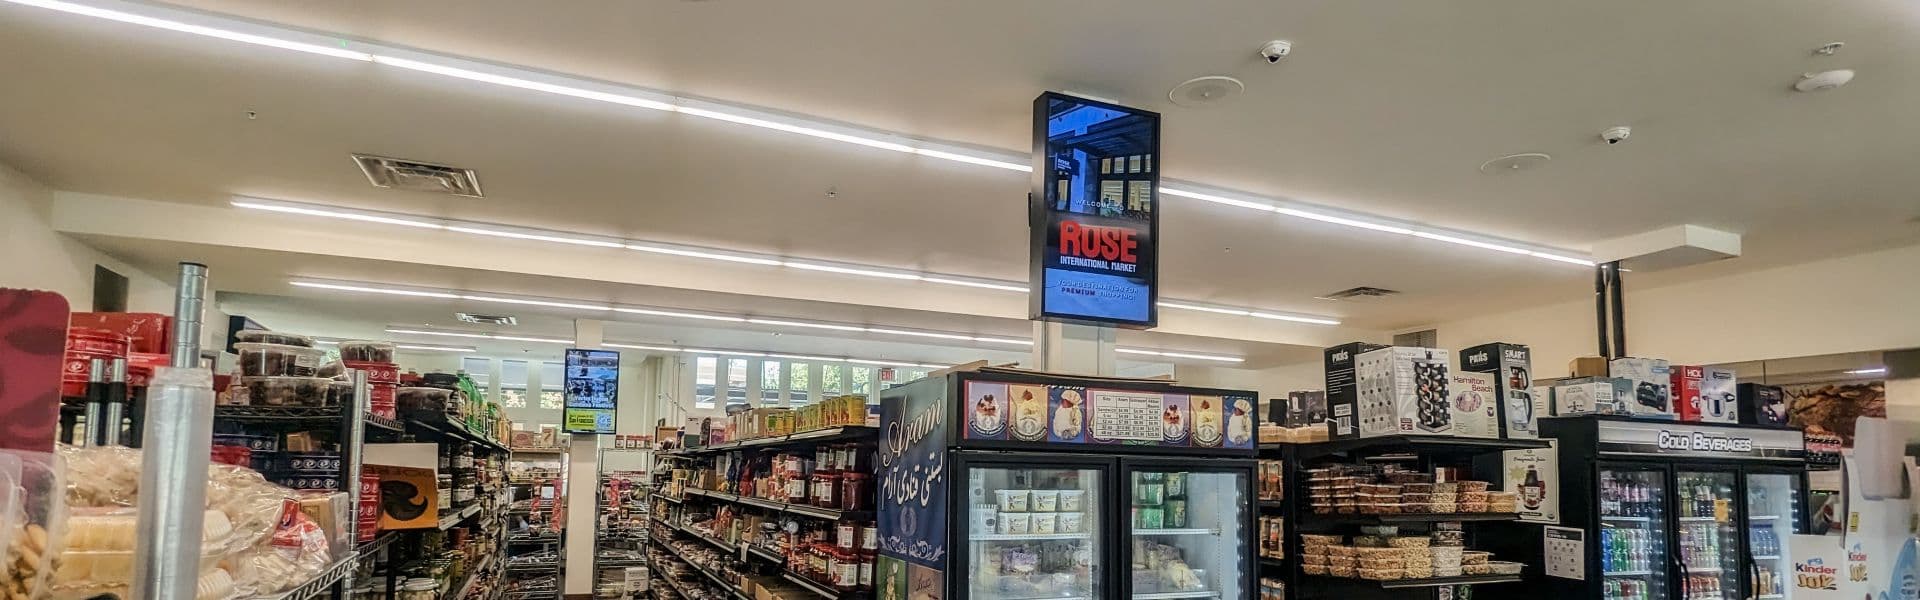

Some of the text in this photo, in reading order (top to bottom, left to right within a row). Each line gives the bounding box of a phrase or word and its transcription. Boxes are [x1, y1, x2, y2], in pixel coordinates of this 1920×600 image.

[1076, 199, 1110, 209] WELCOME
[1060, 220, 1137, 263] ROSE
[1060, 255, 1137, 273] INTERNATIONAL MARKET
[1061, 287, 1096, 297] PREMIUM
[1504, 350, 1526, 359] SMART
[1453, 375, 1485, 385] Hamilton
[1471, 384, 1493, 393] Beach
[883, 396, 943, 467] Aram
[1795, 562, 1838, 574] Kinder
